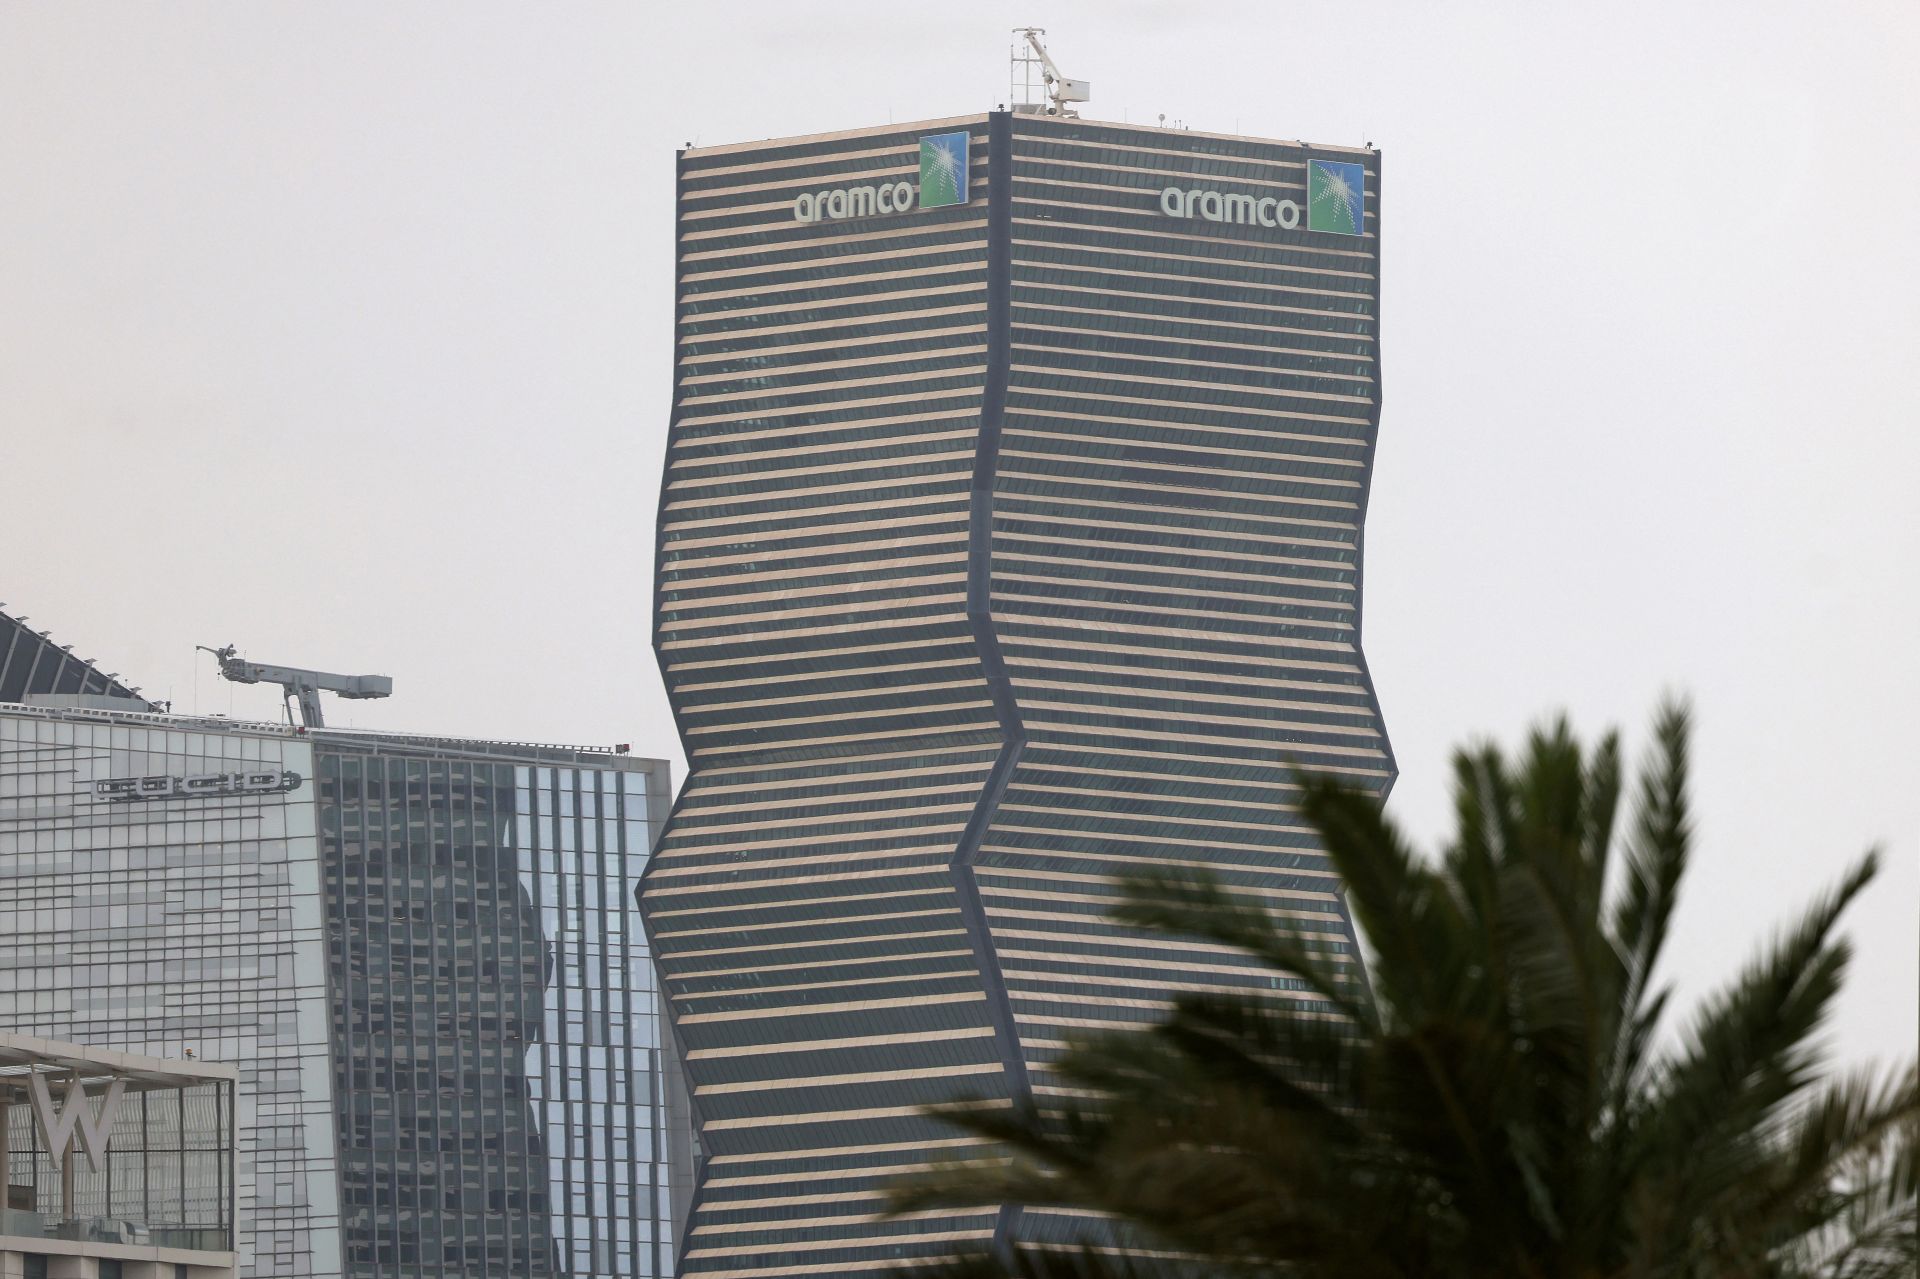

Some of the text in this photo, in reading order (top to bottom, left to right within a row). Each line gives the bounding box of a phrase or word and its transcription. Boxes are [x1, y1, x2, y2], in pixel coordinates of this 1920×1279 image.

[794, 181, 914, 223] aramco
[1160, 186, 1300, 230] aramco
[91, 769, 284, 800] LUCID
[28, 1072, 127, 1174] W
